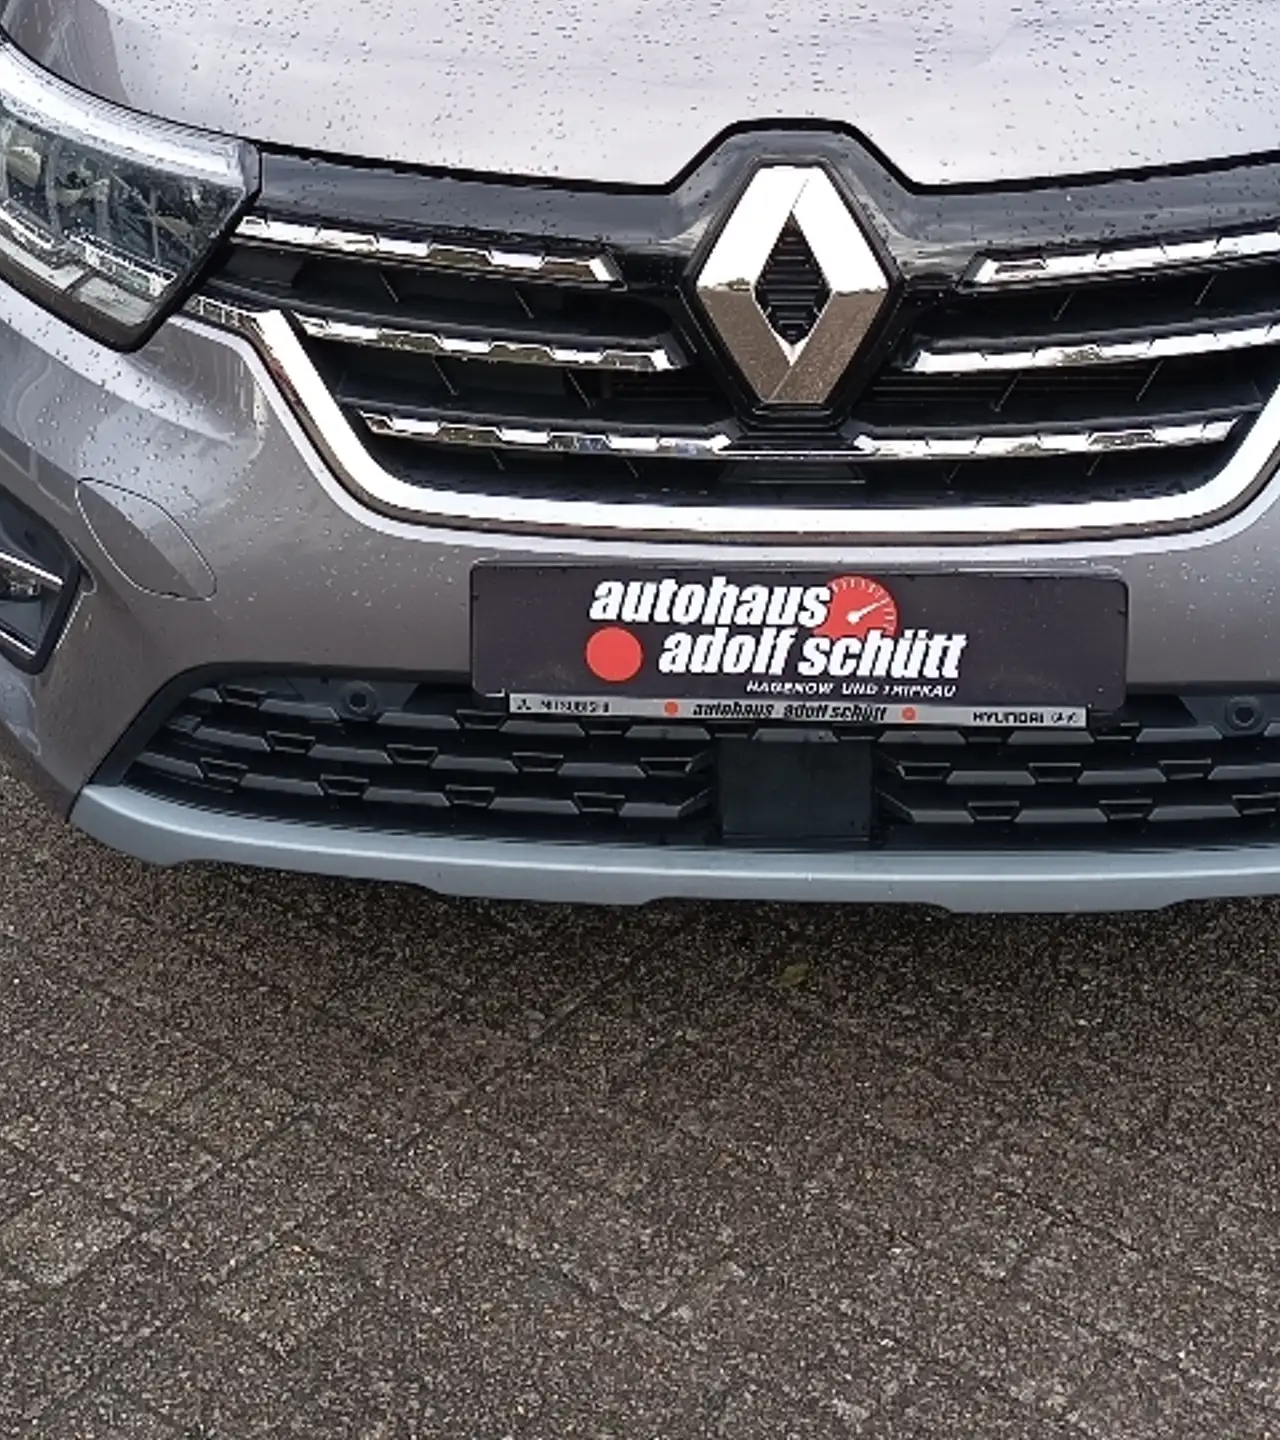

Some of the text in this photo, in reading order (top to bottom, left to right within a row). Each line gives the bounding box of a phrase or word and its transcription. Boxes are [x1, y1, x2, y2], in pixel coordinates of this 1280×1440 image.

[589, 576, 831, 627] autohaus
[658, 627, 969, 680] adolf schütt
